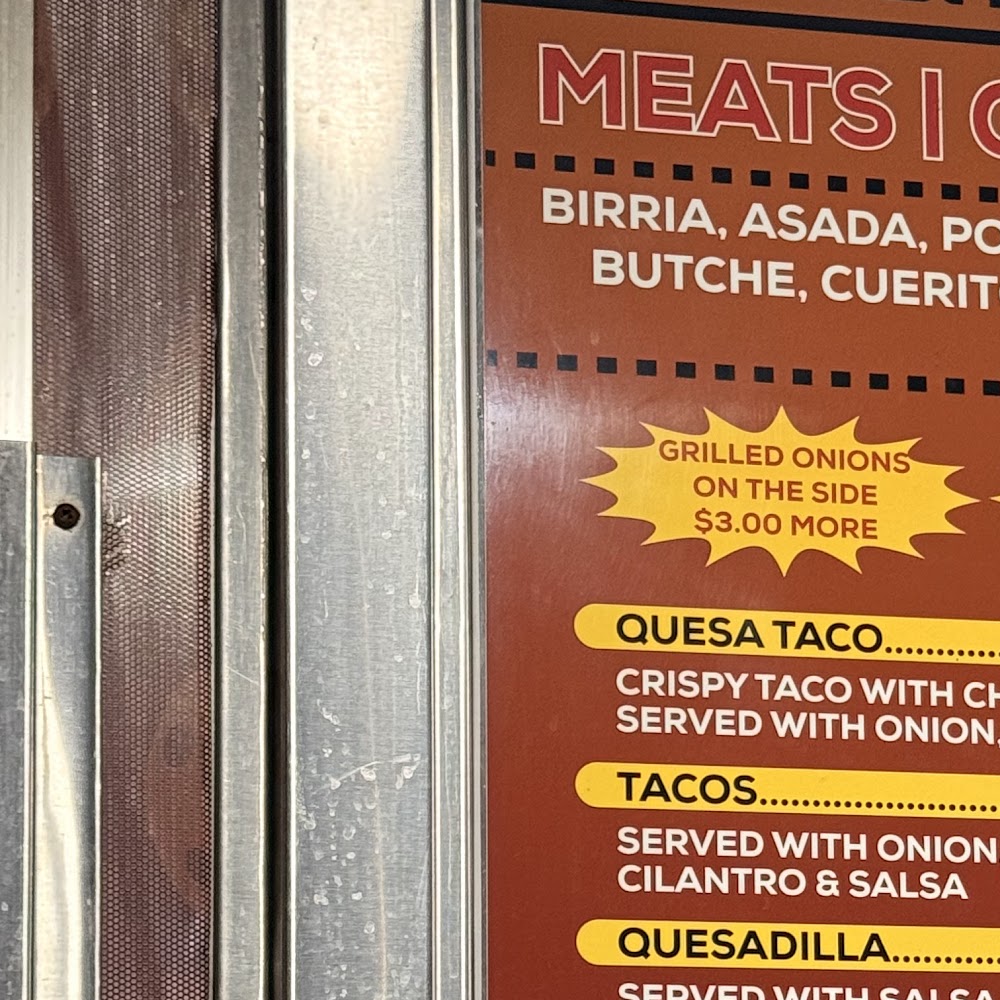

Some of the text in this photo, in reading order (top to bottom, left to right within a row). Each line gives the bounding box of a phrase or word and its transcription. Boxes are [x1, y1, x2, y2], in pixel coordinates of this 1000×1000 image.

[539, 43, 896, 150] MEATS
[543, 188, 727, 239] BIRRIA,
[739, 206, 927, 253] ASADA,
[593, 249, 807, 302] BUTCHE,
[659, 440, 914, 473] GRILLED ONIONS
[694, 476, 877, 505] ON THE SIDE
[691, 508, 877, 541] $3.00 MORE
[617, 614, 764, 648] QUESA
[617, 668, 748, 698] CRISPY
[755, 674, 852, 703] TACO
[860, 678, 953, 706] WITH
[617, 705, 762, 736] SERVED
[770, 711, 864, 740] WITH
[618, 827, 763, 856] SERVED
[772, 832, 866, 860] WITH
[618, 865, 968, 899] CILANTRO & SALSA
